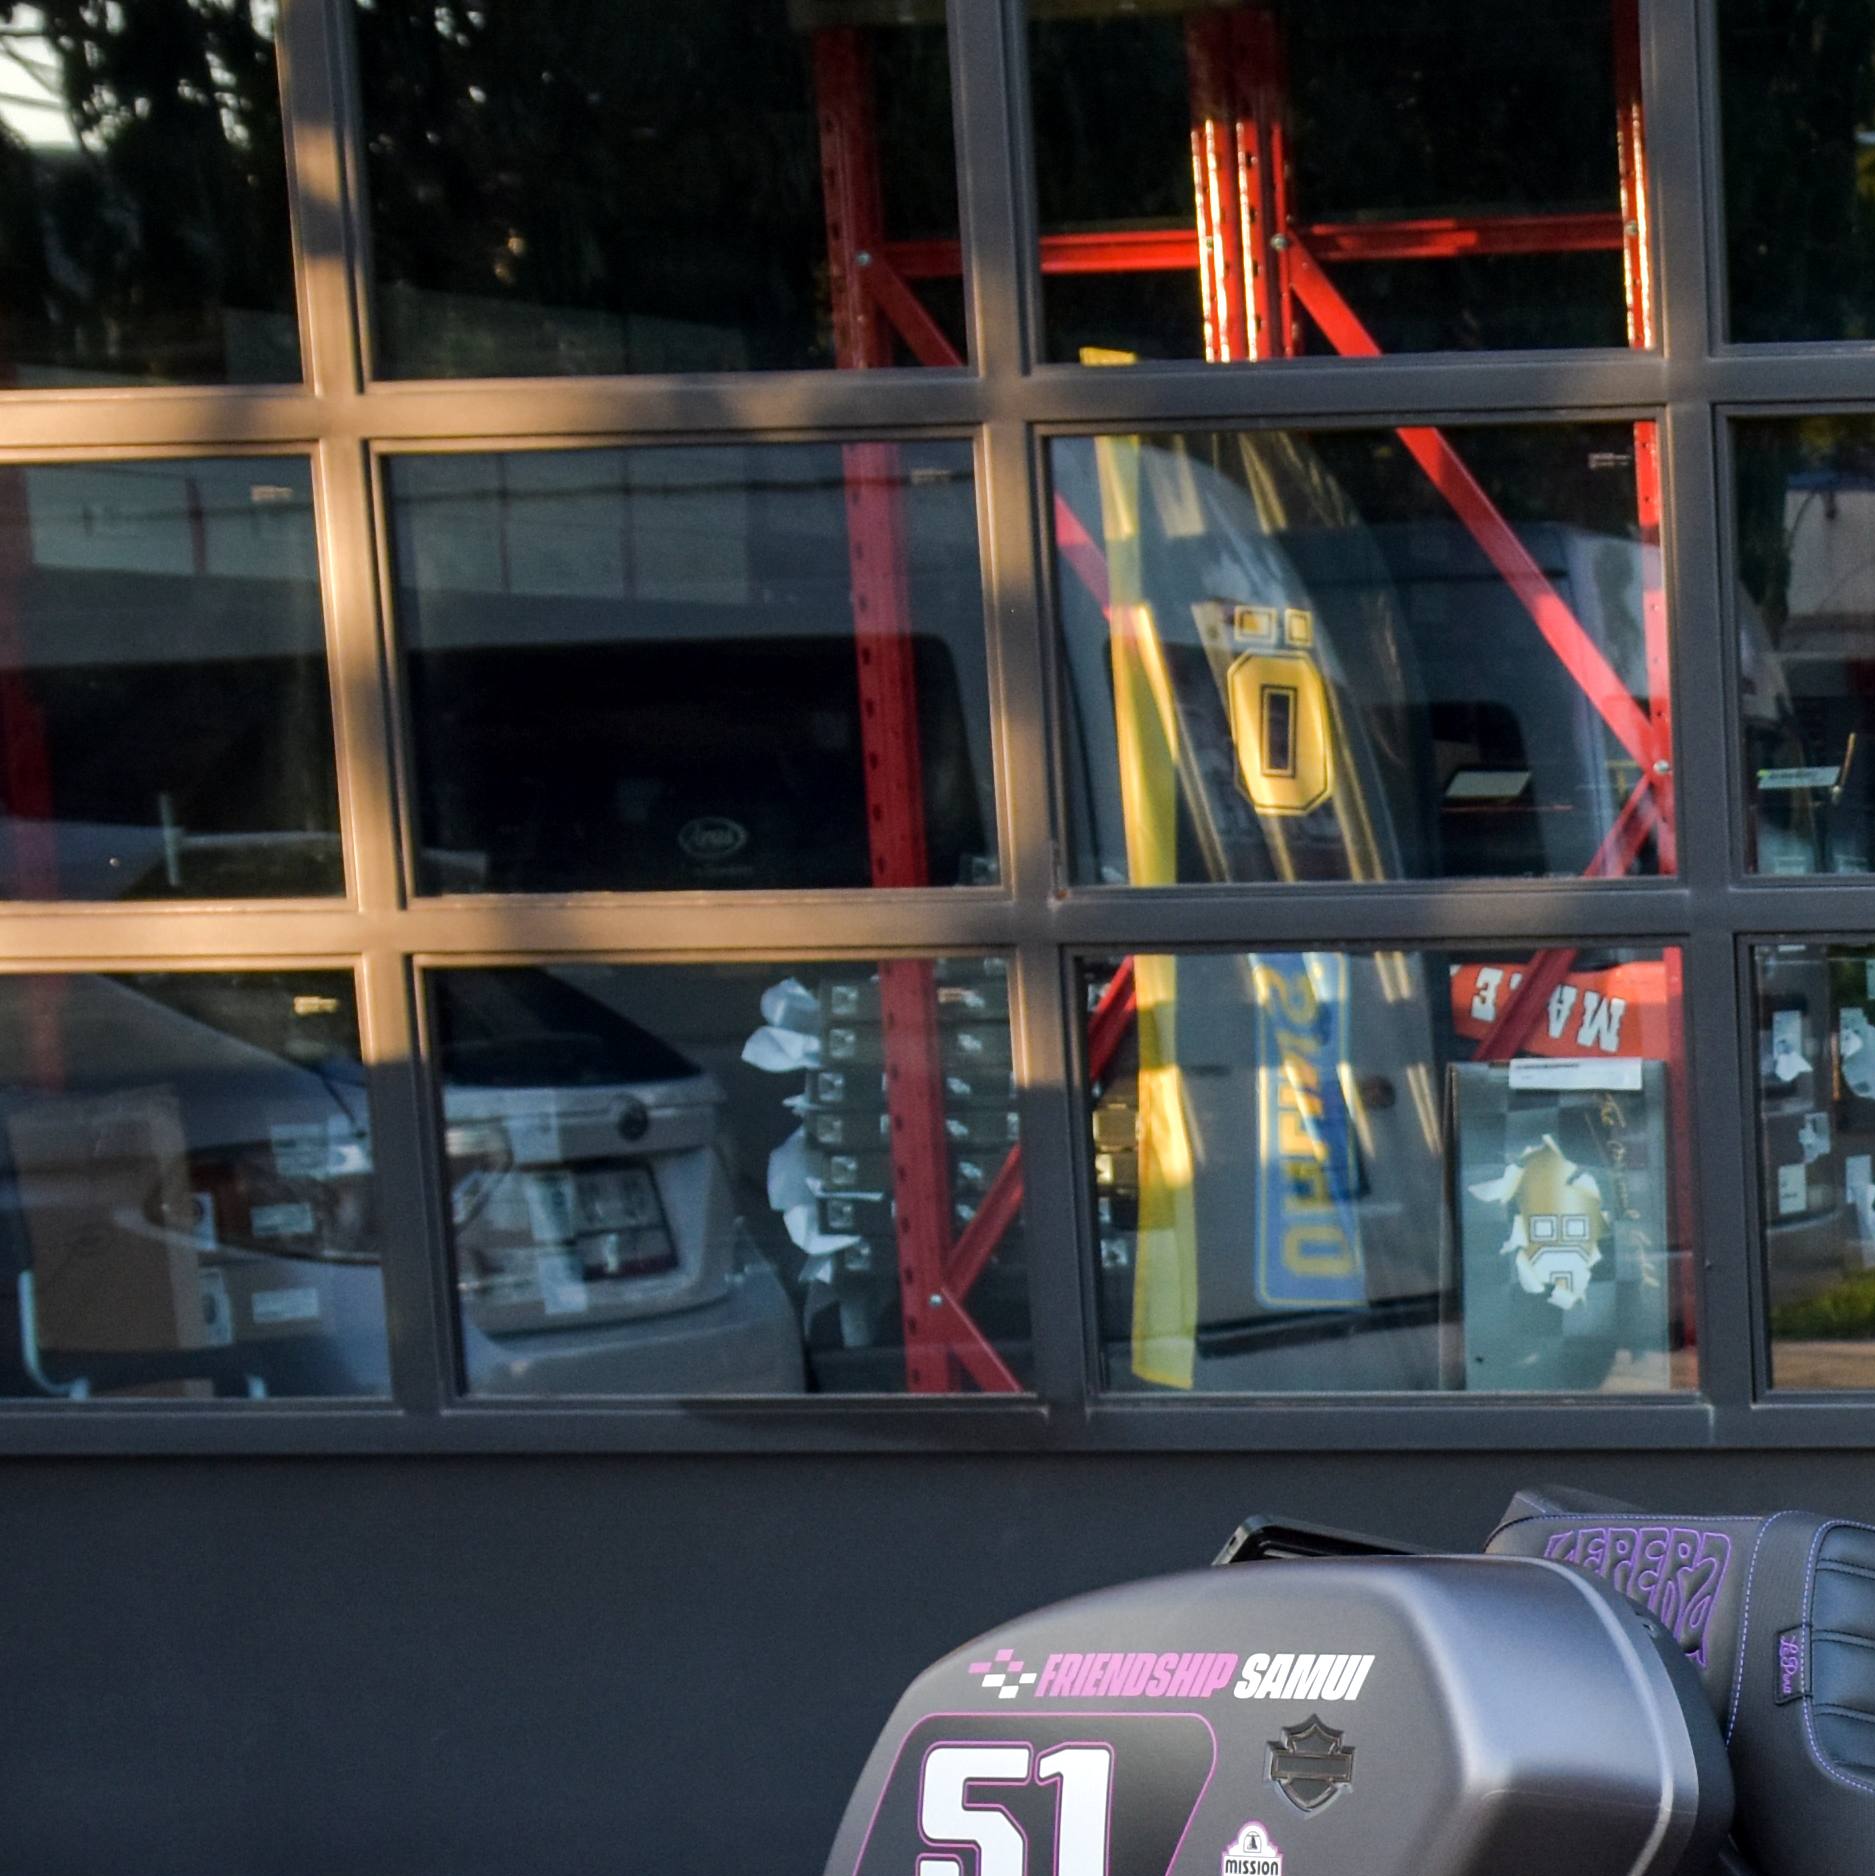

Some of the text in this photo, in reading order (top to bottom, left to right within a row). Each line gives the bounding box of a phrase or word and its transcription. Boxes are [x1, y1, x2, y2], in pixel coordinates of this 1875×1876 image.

[1471, 966, 1627, 1053] MAE
[1034, 1652, 1376, 1701] FRIENDSHIP SAMUI
